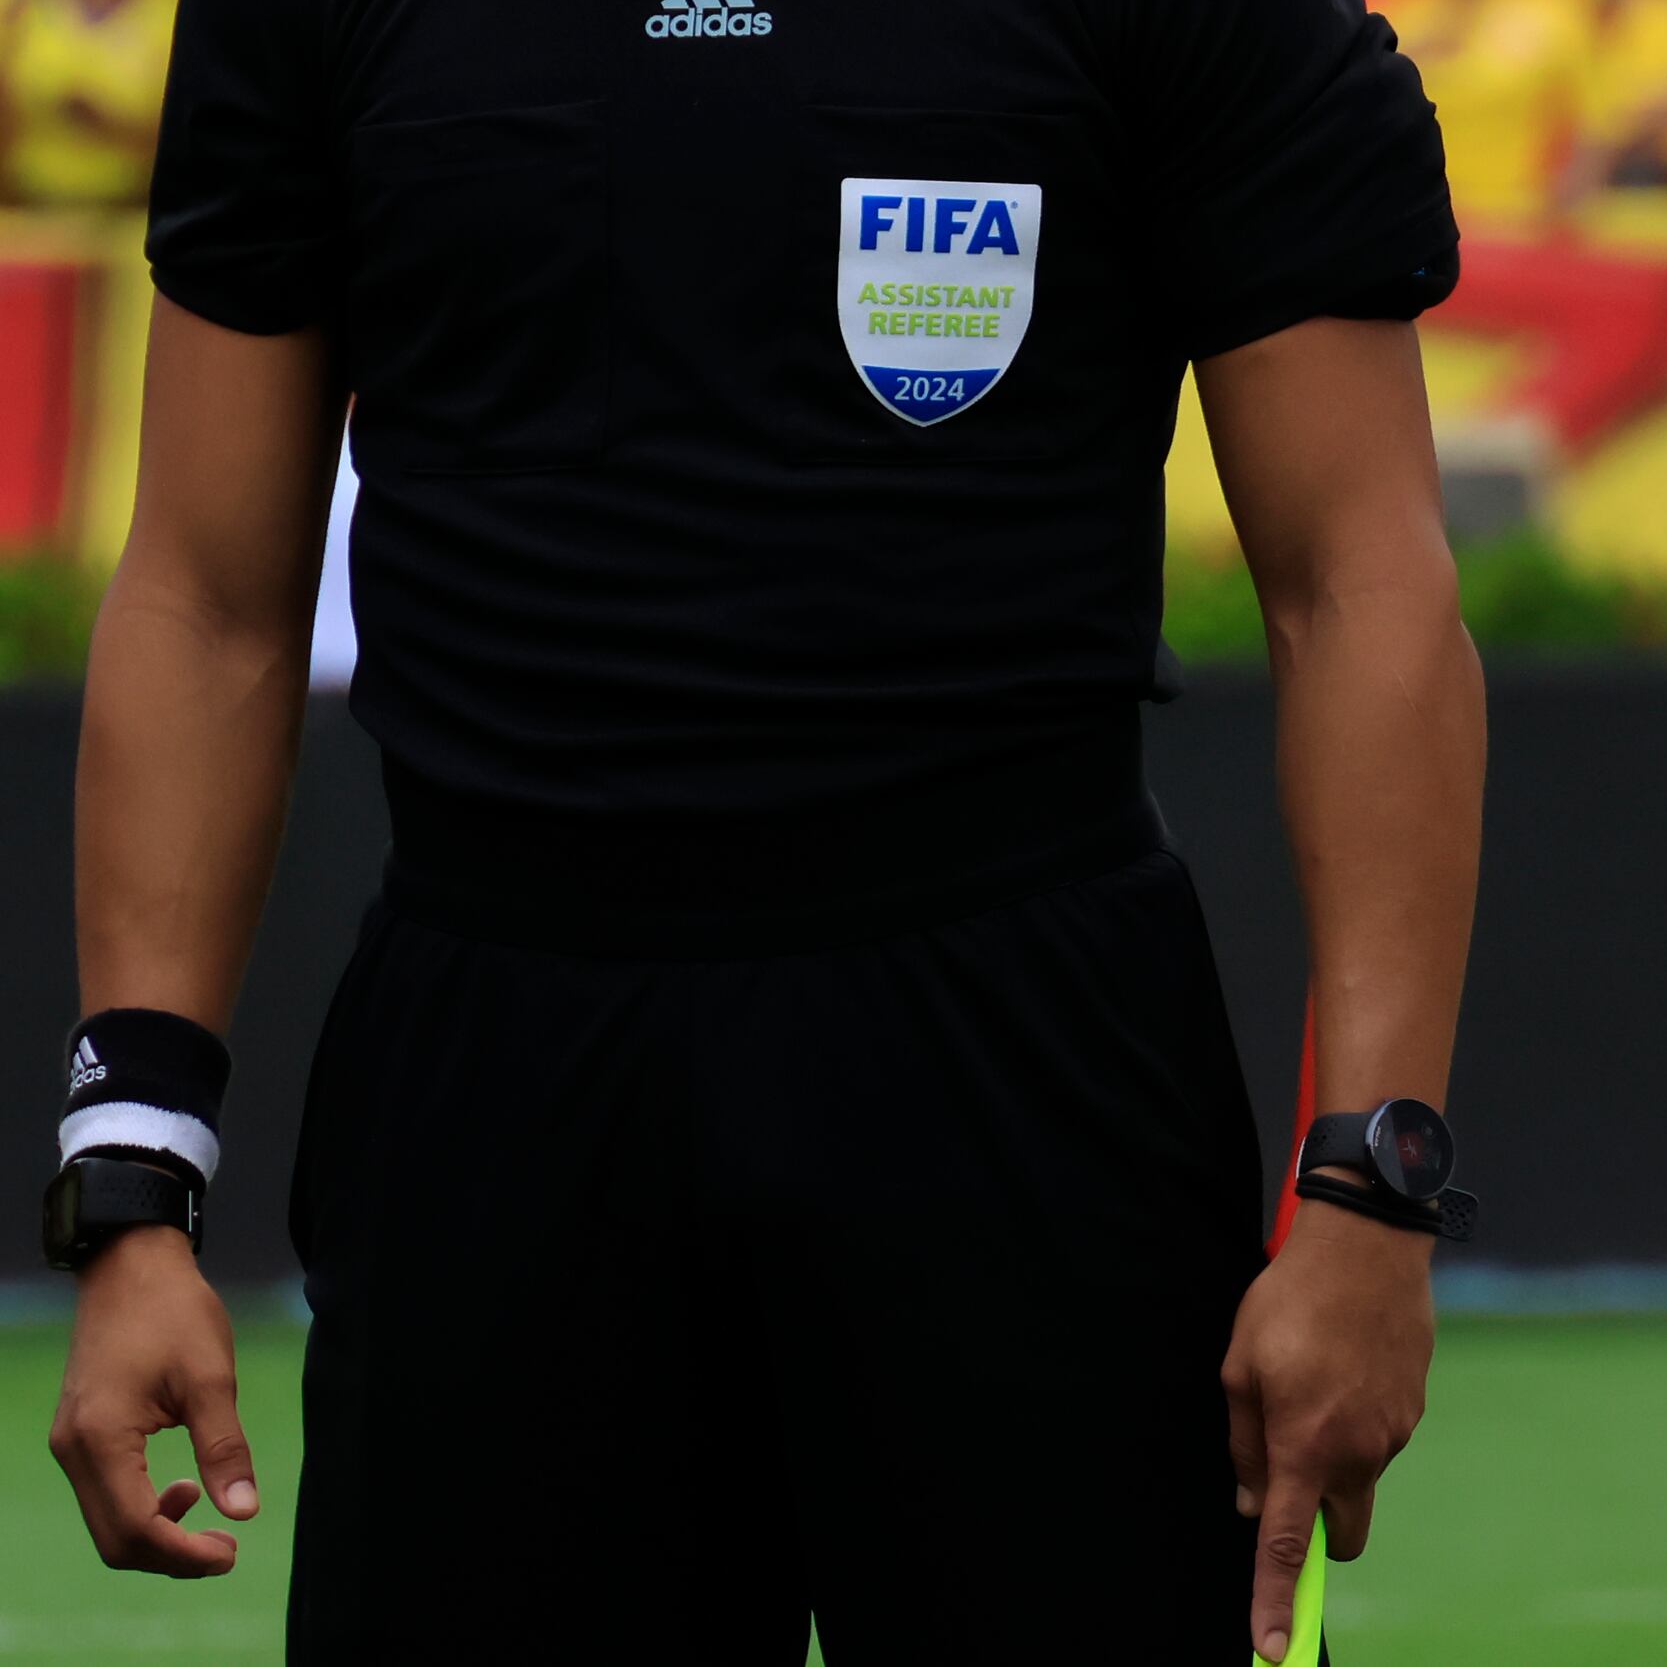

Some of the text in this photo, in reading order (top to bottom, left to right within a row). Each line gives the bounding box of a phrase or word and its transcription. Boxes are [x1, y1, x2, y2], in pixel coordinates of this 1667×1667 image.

[645, 7, 773, 38] adidas
[859, 195, 1020, 255] FIFA
[857, 283, 1016, 311] ASSISTANT
[868, 310, 1001, 339] REFEREE
[894, 377, 966, 402] 2024
